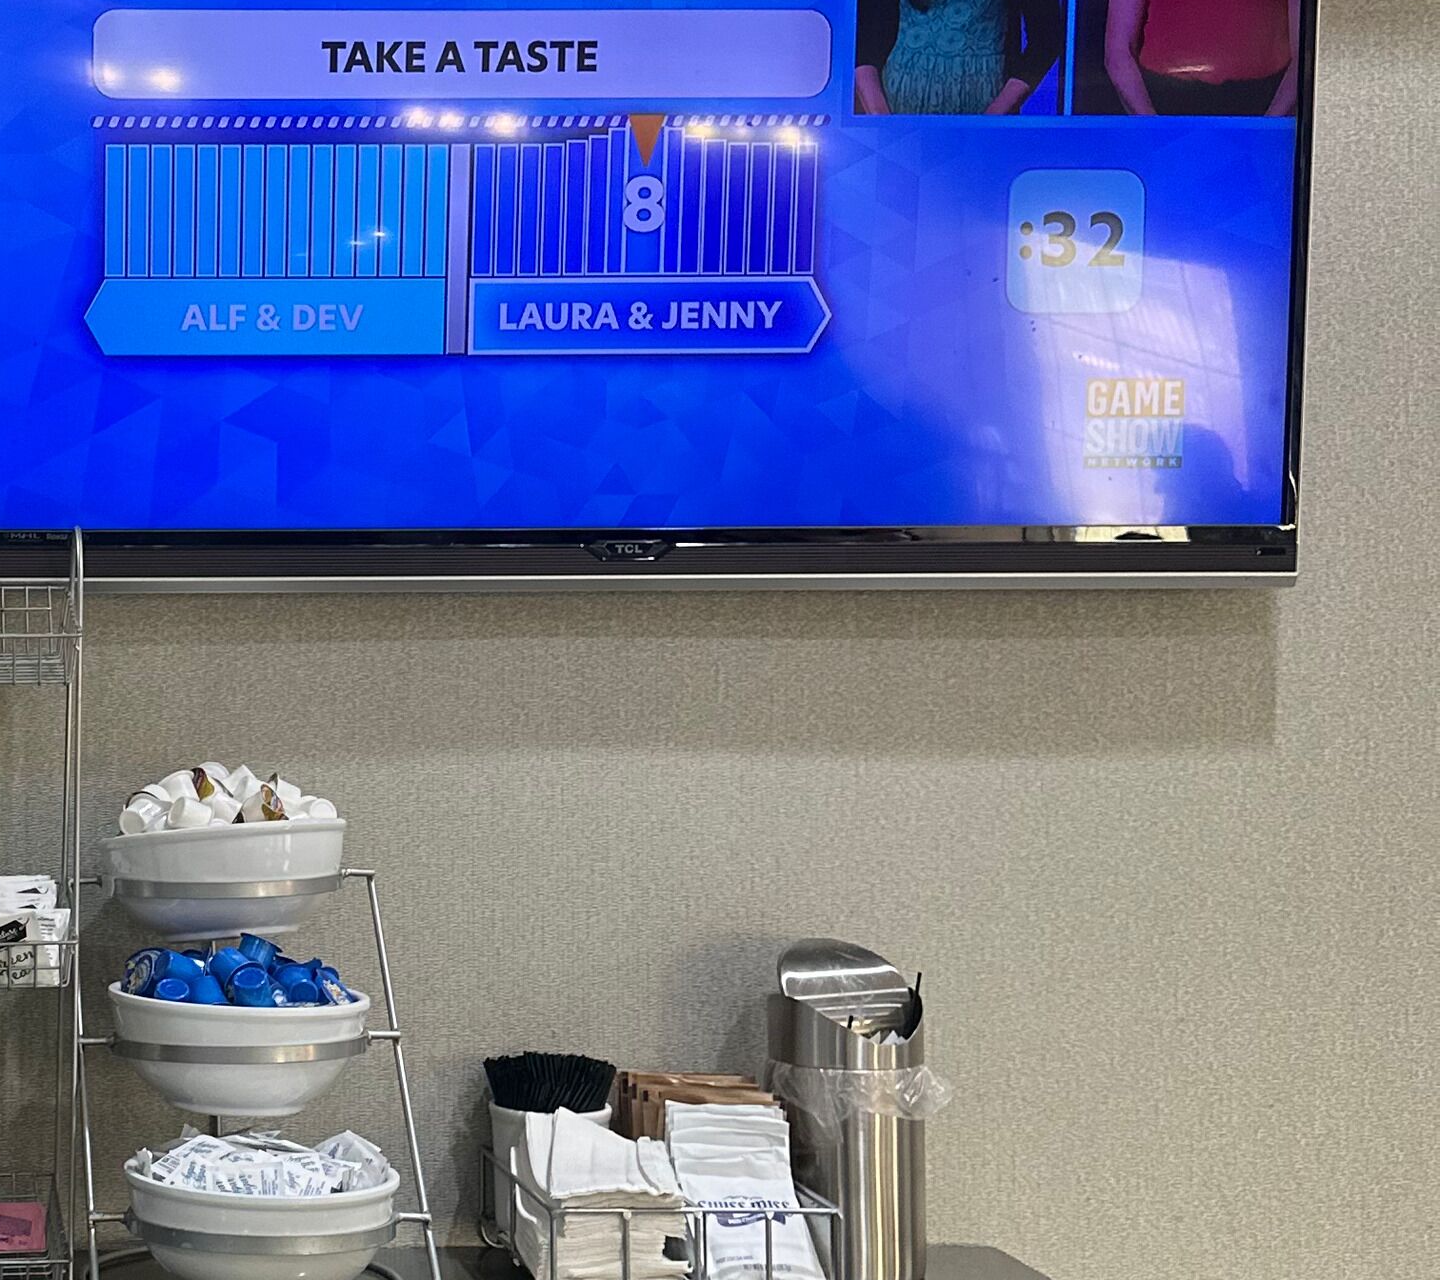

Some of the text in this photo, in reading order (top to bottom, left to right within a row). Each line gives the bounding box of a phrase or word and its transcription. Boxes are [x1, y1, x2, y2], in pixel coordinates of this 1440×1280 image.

[321, 40, 599, 74] TAKE A TASTE
[623, 174, 664, 233] 8
[181, 302, 365, 334] ALF & DEV
[498, 300, 783, 333] LAURA & JENNY
[1086, 380, 1183, 417] GAME
[1085, 418, 1182, 455] SHOW
[614, 543, 644, 554] TCL
